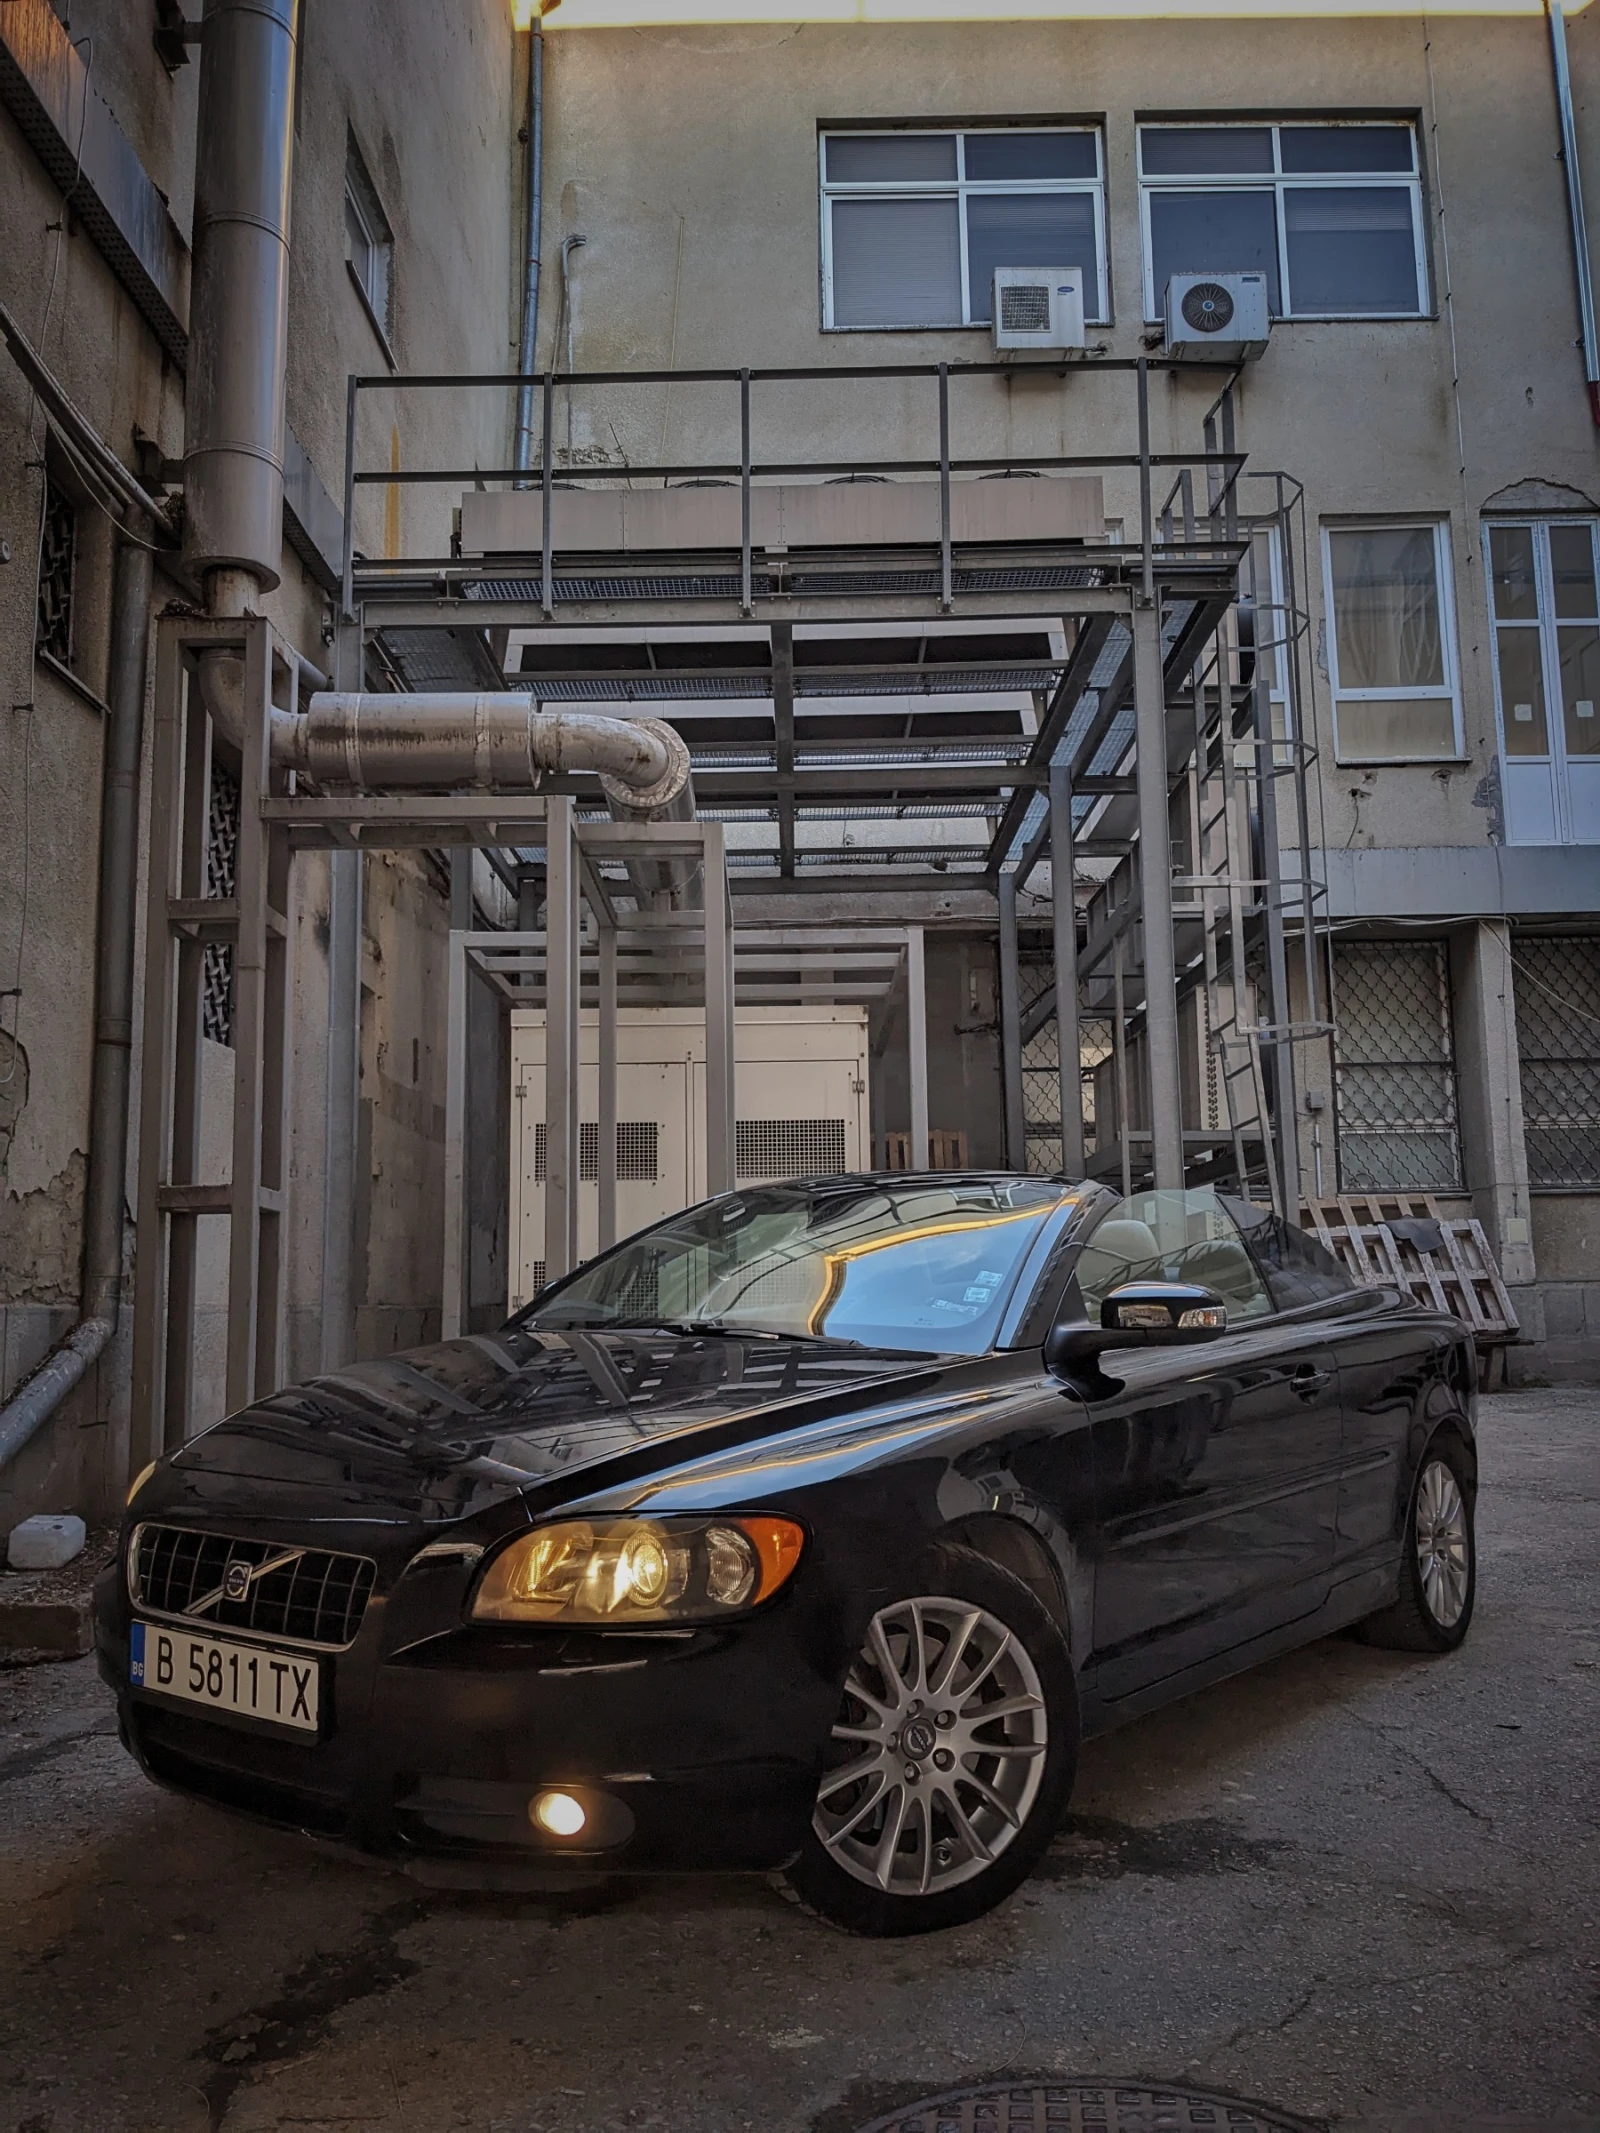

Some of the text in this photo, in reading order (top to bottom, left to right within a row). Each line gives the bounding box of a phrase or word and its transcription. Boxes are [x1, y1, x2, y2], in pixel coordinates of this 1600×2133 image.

[132, 1660, 144, 1677] BG
[157, 1635, 312, 1722] B 5811 TX
